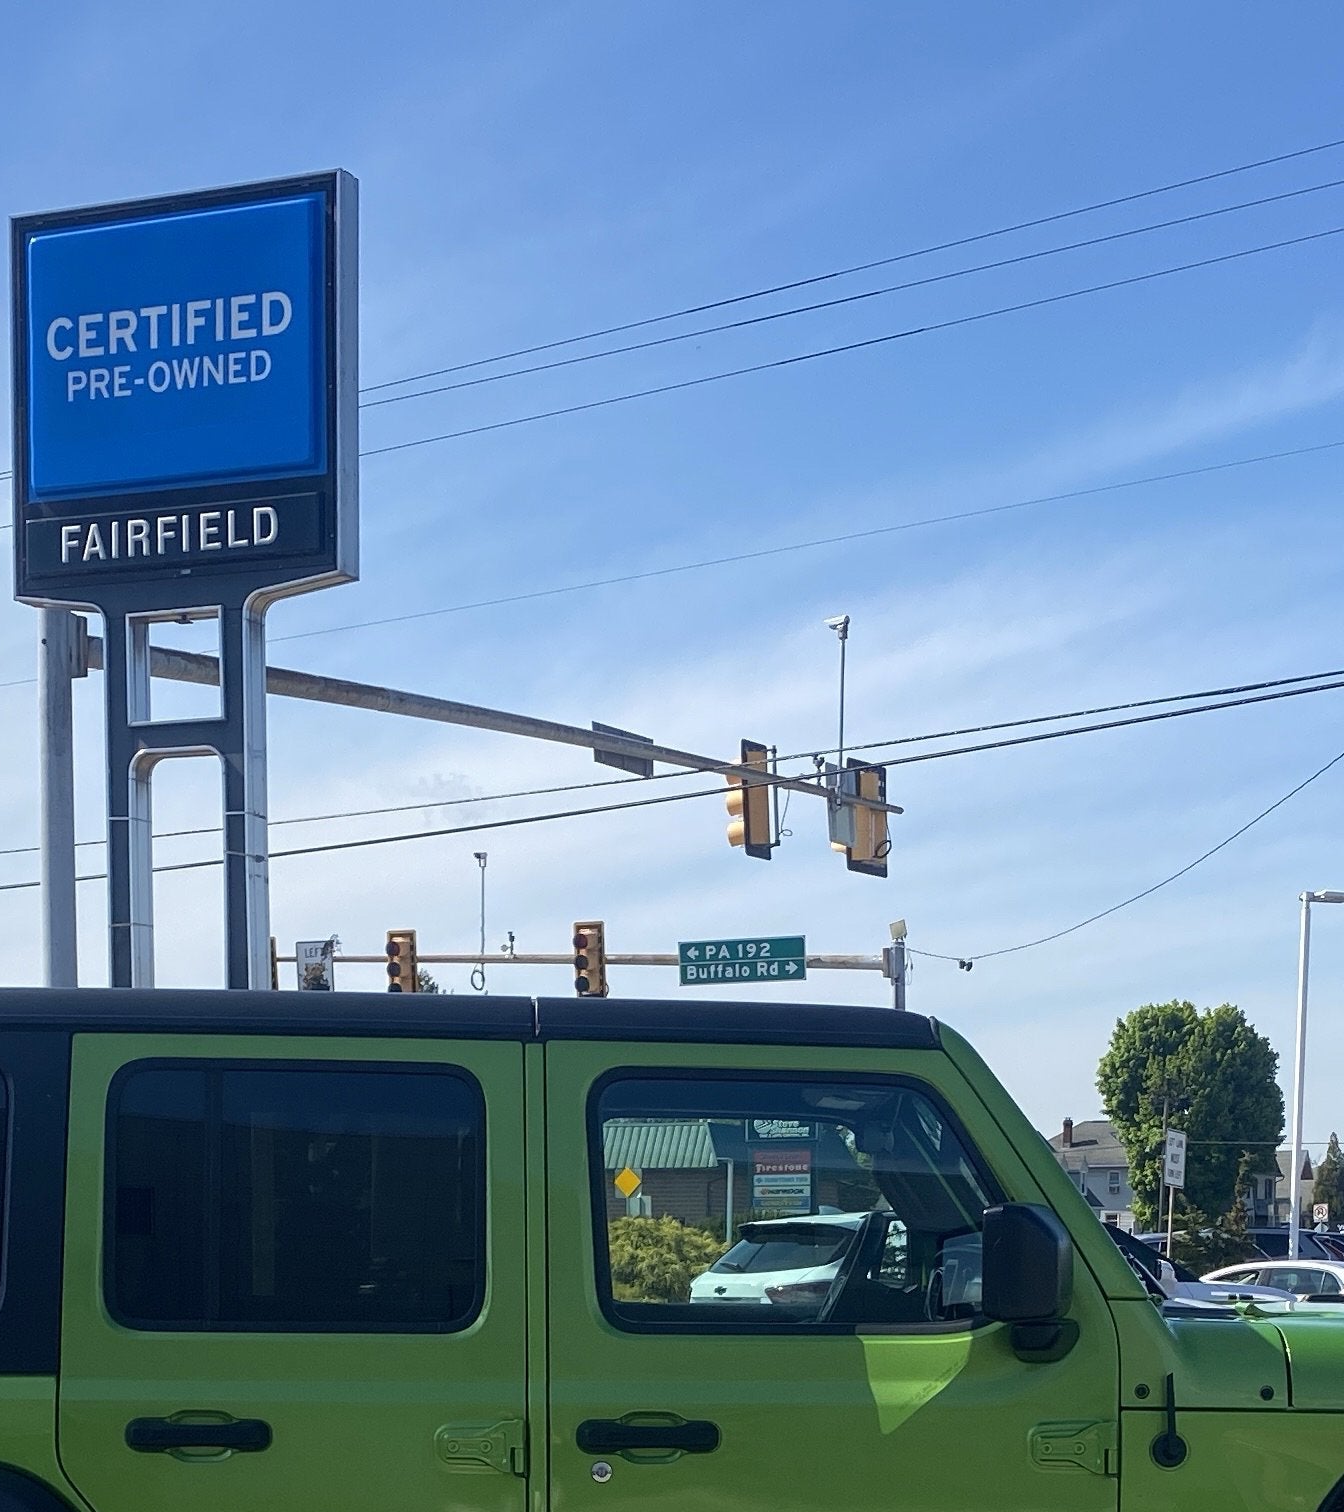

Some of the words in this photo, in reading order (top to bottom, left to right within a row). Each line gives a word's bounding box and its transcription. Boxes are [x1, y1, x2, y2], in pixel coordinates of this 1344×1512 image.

[46, 291, 292, 361] CERTIFIED
[67, 349, 272, 402] PRE-OWNED
[61, 506, 279, 563] FAIRFIELD
[705, 944, 731, 959] PA
[737, 942, 770, 958] 192
[687, 964, 750, 979] Buffalo
[757, 962, 778, 976] Rd
[755, 1163, 808, 1173] Firestone
